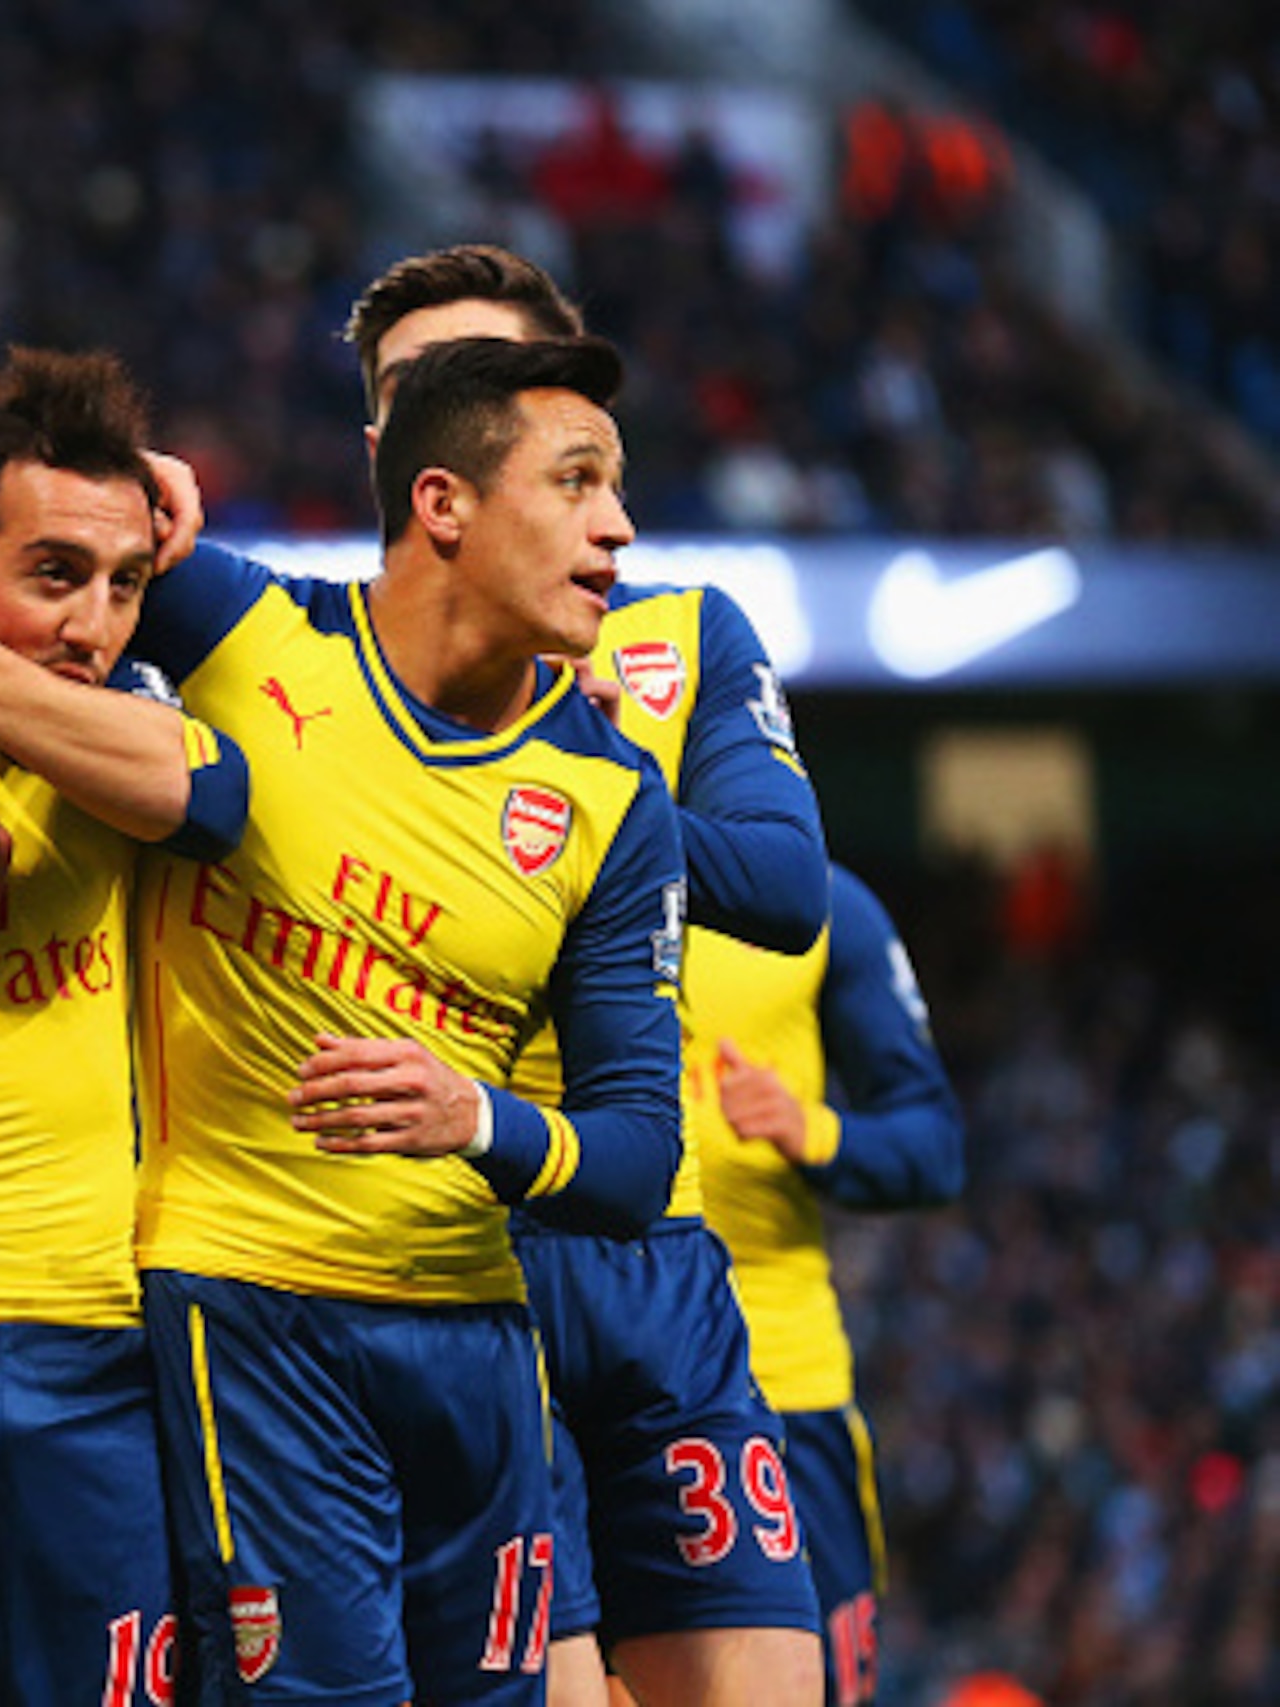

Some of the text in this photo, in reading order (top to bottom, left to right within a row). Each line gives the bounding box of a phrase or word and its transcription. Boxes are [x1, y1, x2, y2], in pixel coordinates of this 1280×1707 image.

[332, 853, 442, 948] Fly
[665, 1437, 800, 1565] 39
[478, 1532, 554, 1674] 17
